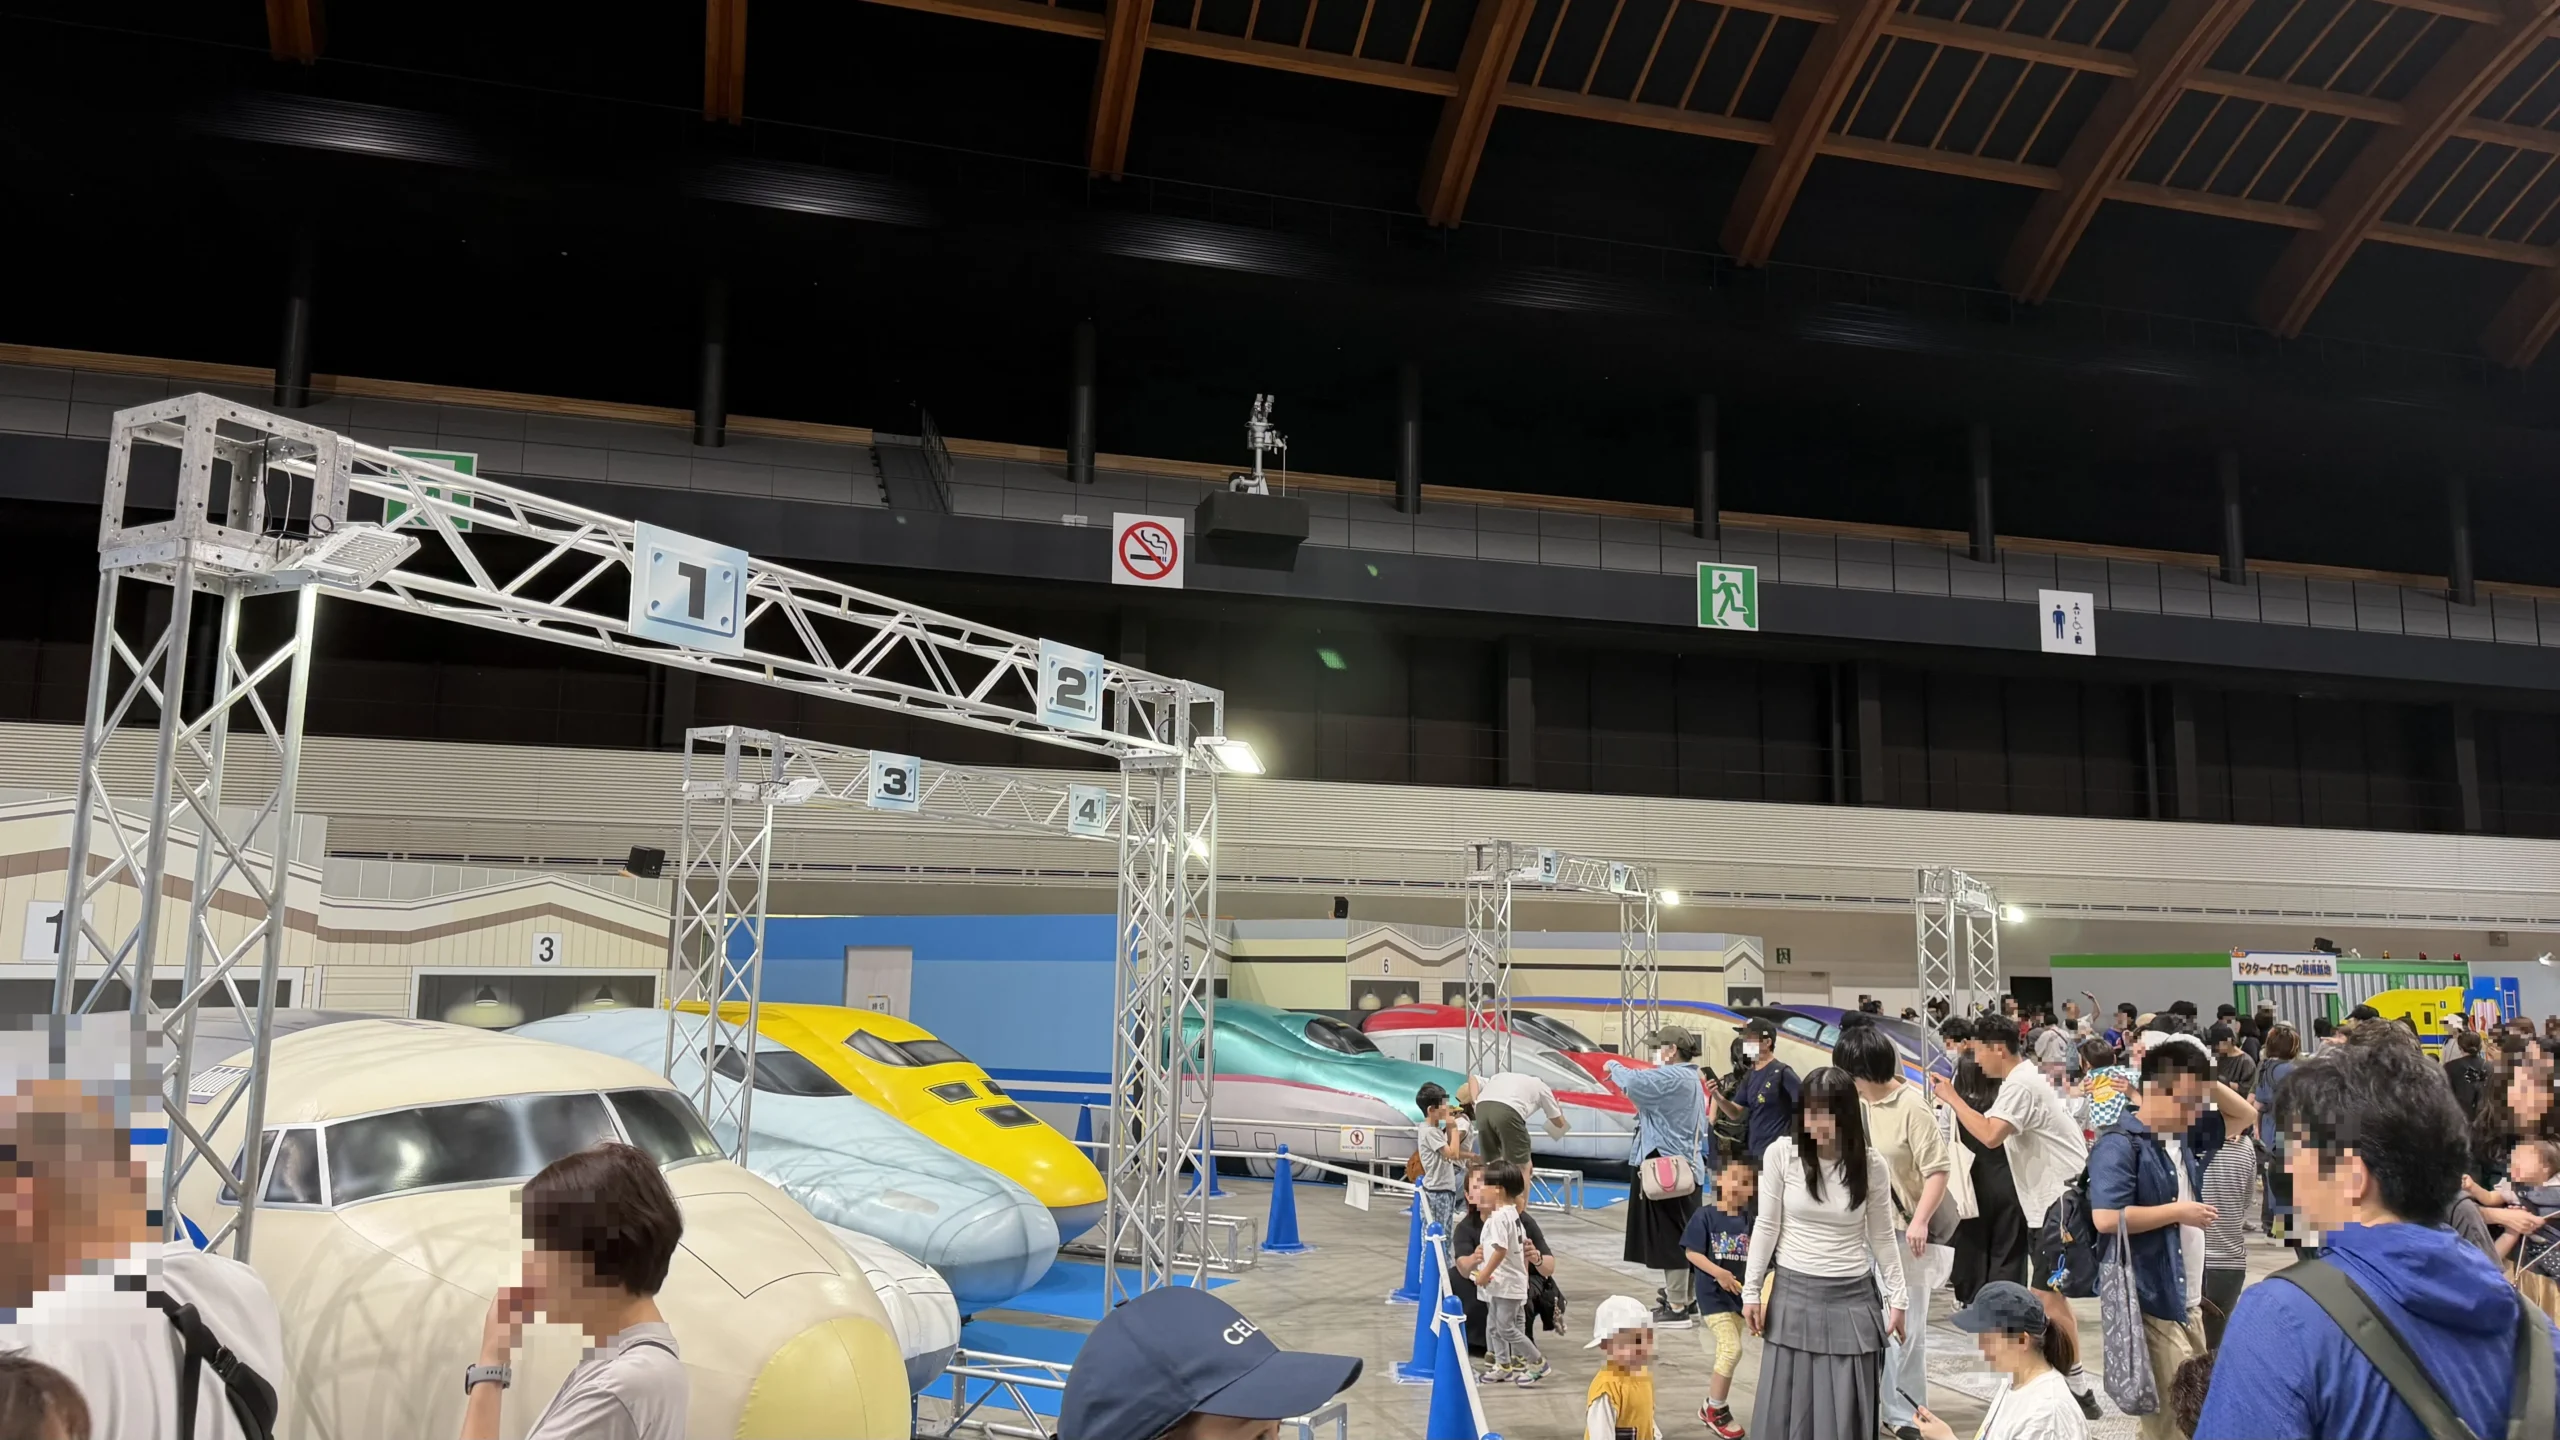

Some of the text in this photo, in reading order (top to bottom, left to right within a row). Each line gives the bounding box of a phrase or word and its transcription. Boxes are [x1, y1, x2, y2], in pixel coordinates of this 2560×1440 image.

[678, 561, 707, 620] 1
[1056, 666, 1087, 711] 2
[883, 767, 907, 795] 3
[1078, 798, 1097, 822] 4
[1543, 857, 1552, 874] 5
[1614, 869, 1621, 883] 6
[46, 909, 64, 954] 1
[539, 936, 554, 962] 3
[1183, 955, 1190, 971] 5
[1383, 958, 1390, 973] 6
[1223, 1318, 1259, 1345] CEL
